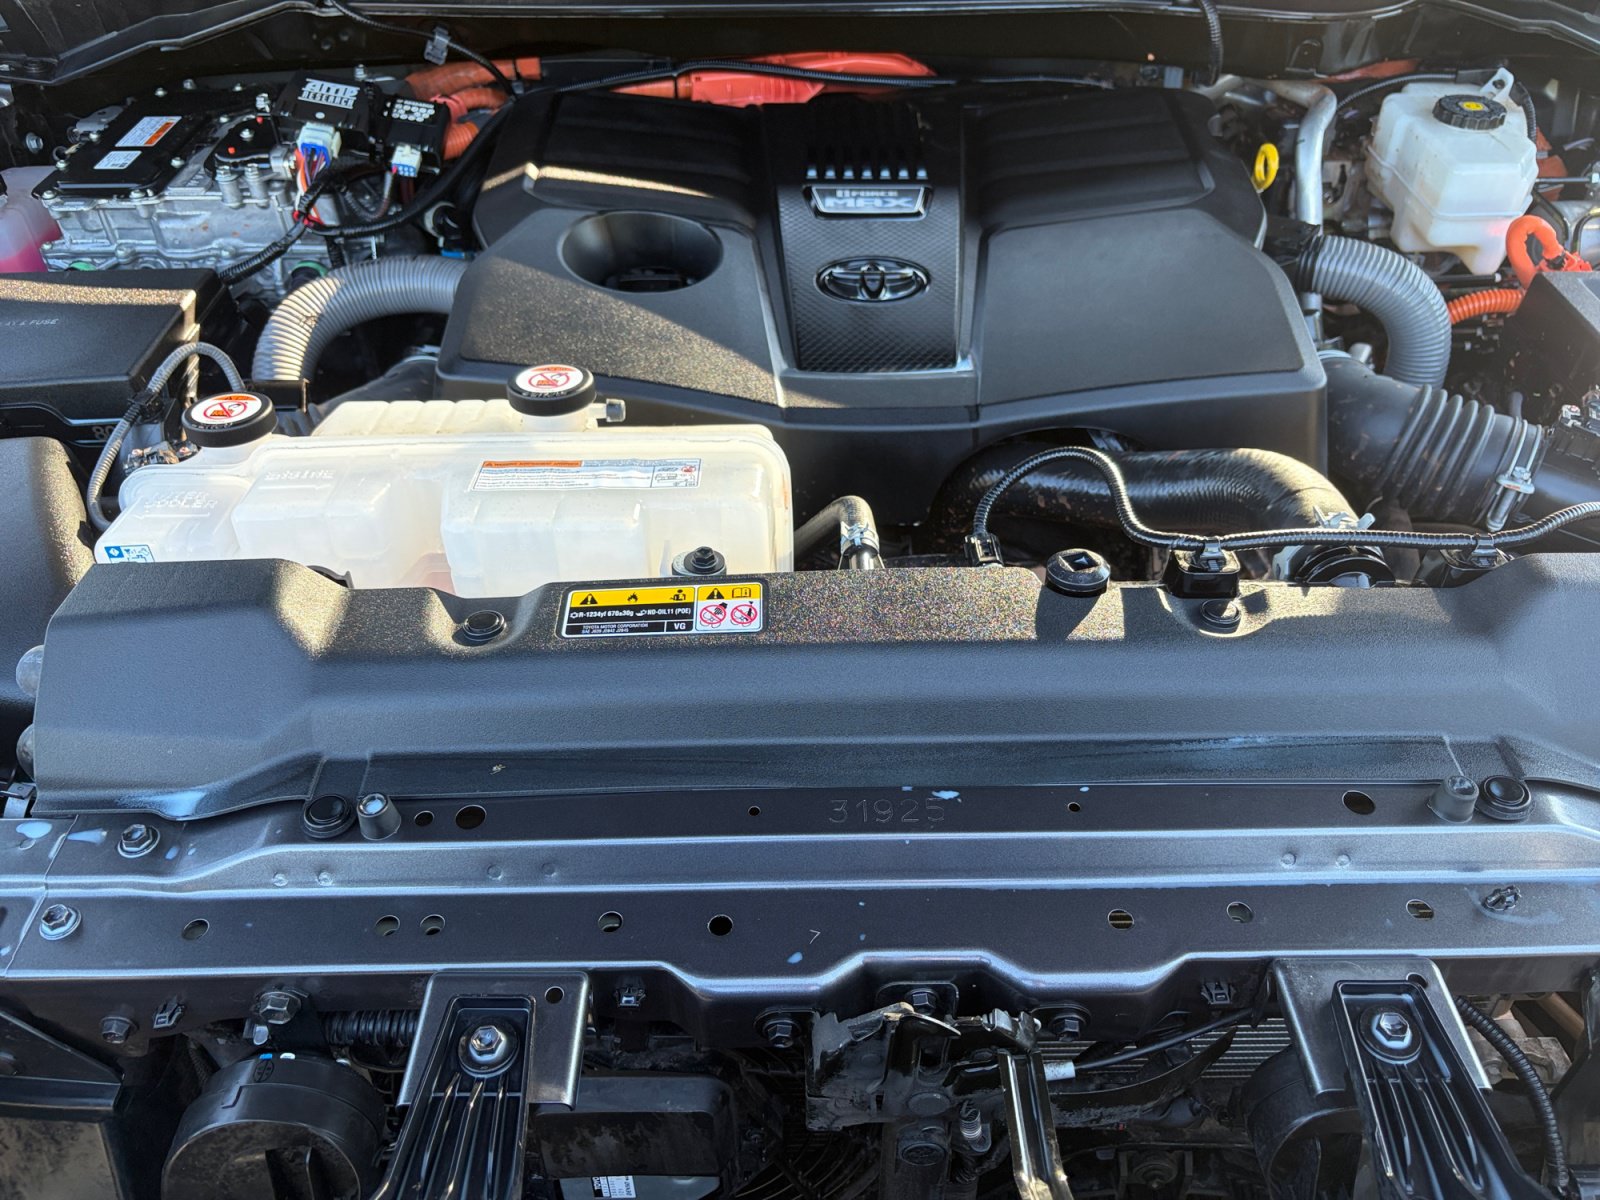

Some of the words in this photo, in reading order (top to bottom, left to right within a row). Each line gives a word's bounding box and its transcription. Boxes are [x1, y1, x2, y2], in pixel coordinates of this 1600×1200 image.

[301, 91, 355, 108] RESEARCH
[824, 197, 913, 208] MAX
[675, 607, 691, 616] (POE)
[674, 622, 686, 630] VG
[829, 799, 945, 823] 31925
